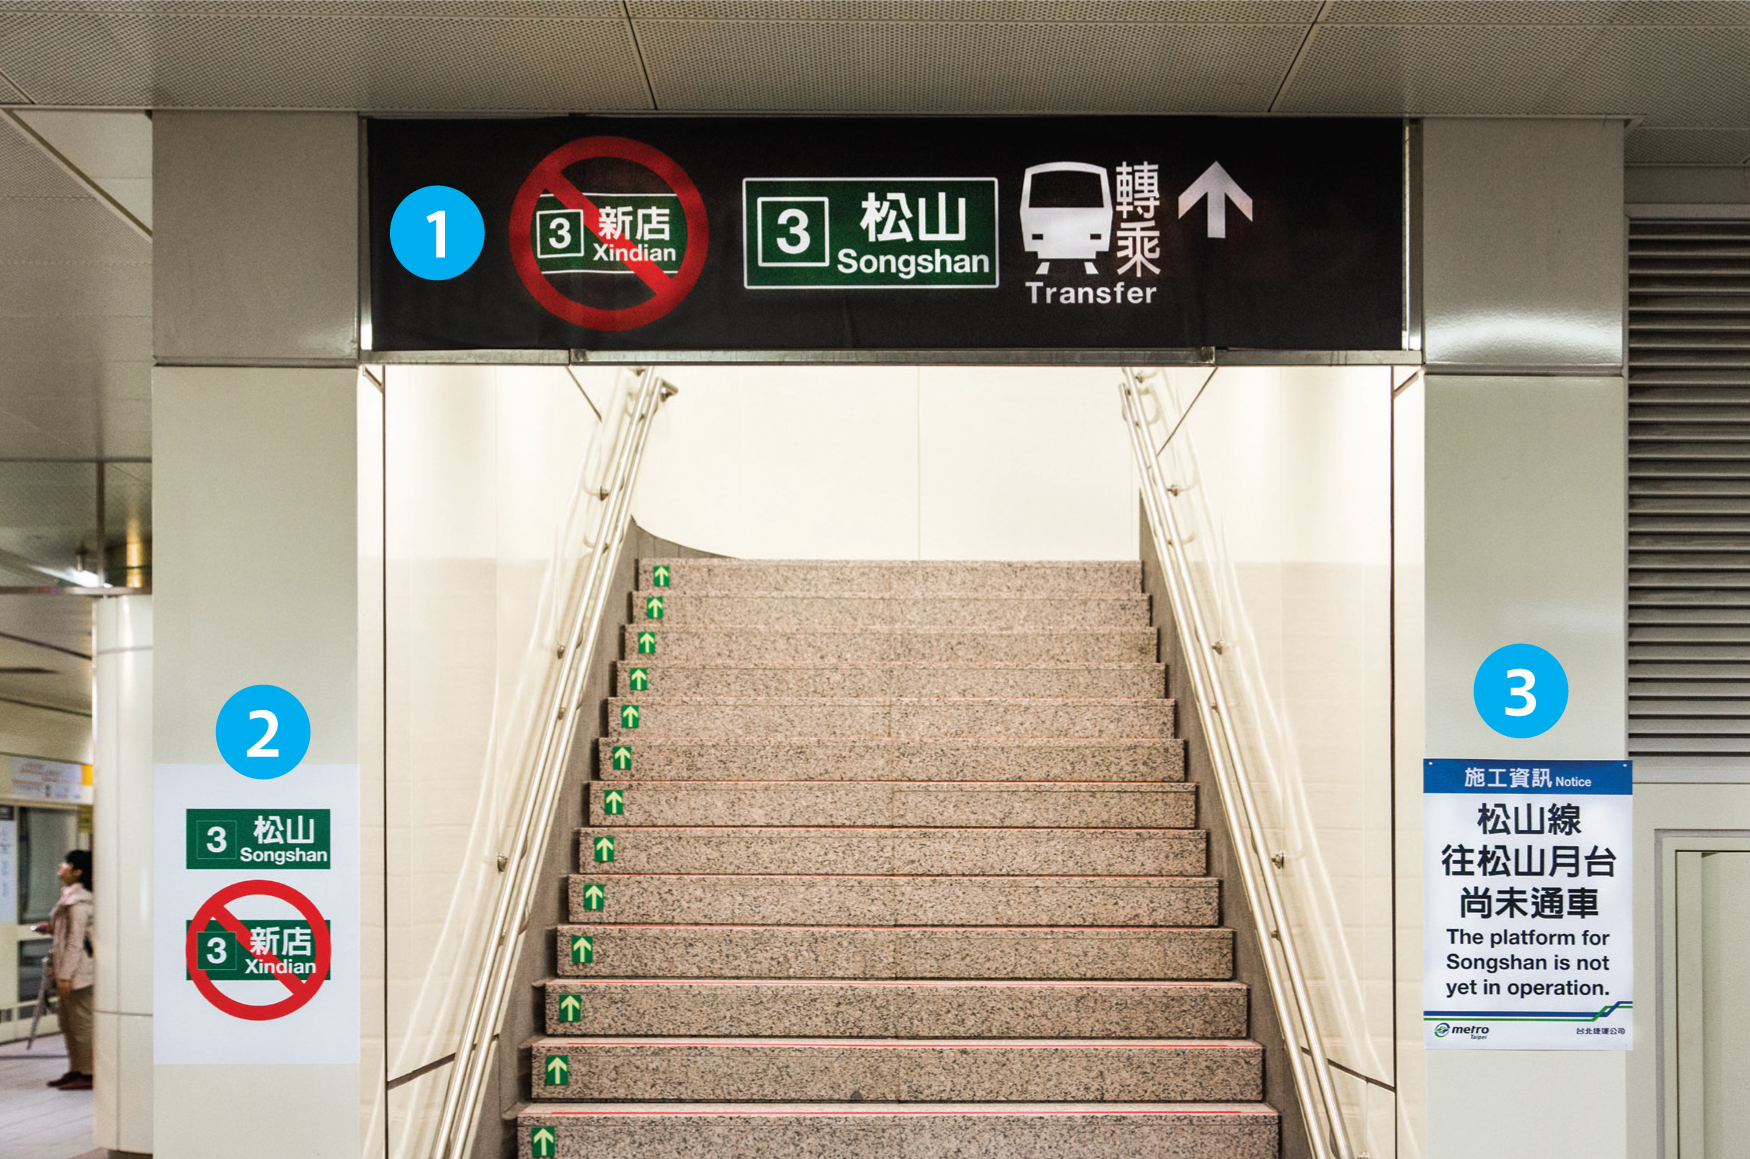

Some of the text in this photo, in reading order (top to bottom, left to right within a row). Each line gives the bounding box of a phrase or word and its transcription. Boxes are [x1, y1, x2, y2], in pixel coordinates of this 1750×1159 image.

[598, 205, 670, 241] 新店
[860, 192, 967, 243] 松山
[1115, 161, 1162, 278] 轉乘
[548, 217, 572, 249] 3
[776, 208, 811, 255] 3
[592, 243, 677, 262] Xindian
[836, 248, 990, 275] Songshan
[1025, 281, 1157, 305] Transfer
[1464, 767, 1592, 788] 施工資訊 Notice
[253, 815, 315, 845] 松山
[1477, 803, 1582, 836] 松山線
[205, 826, 228, 853] 3
[239, 847, 328, 865] Songshan
[1441, 843, 1617, 878] 往松山月台
[1460, 886, 1599, 919] 尚未通車
[205, 937, 228, 964] 3
[249, 926, 312, 957] 新店
[1446, 928, 1611, 949] The platform for
[244, 959, 317, 975] Xindian
[1446, 953, 1610, 974] Songshan is not
[1446, 978, 1610, 999] yet in operation.
[1451, 1025, 1490, 1035] metro
[1576, 1027, 1626, 1035] 台北捷運公司
